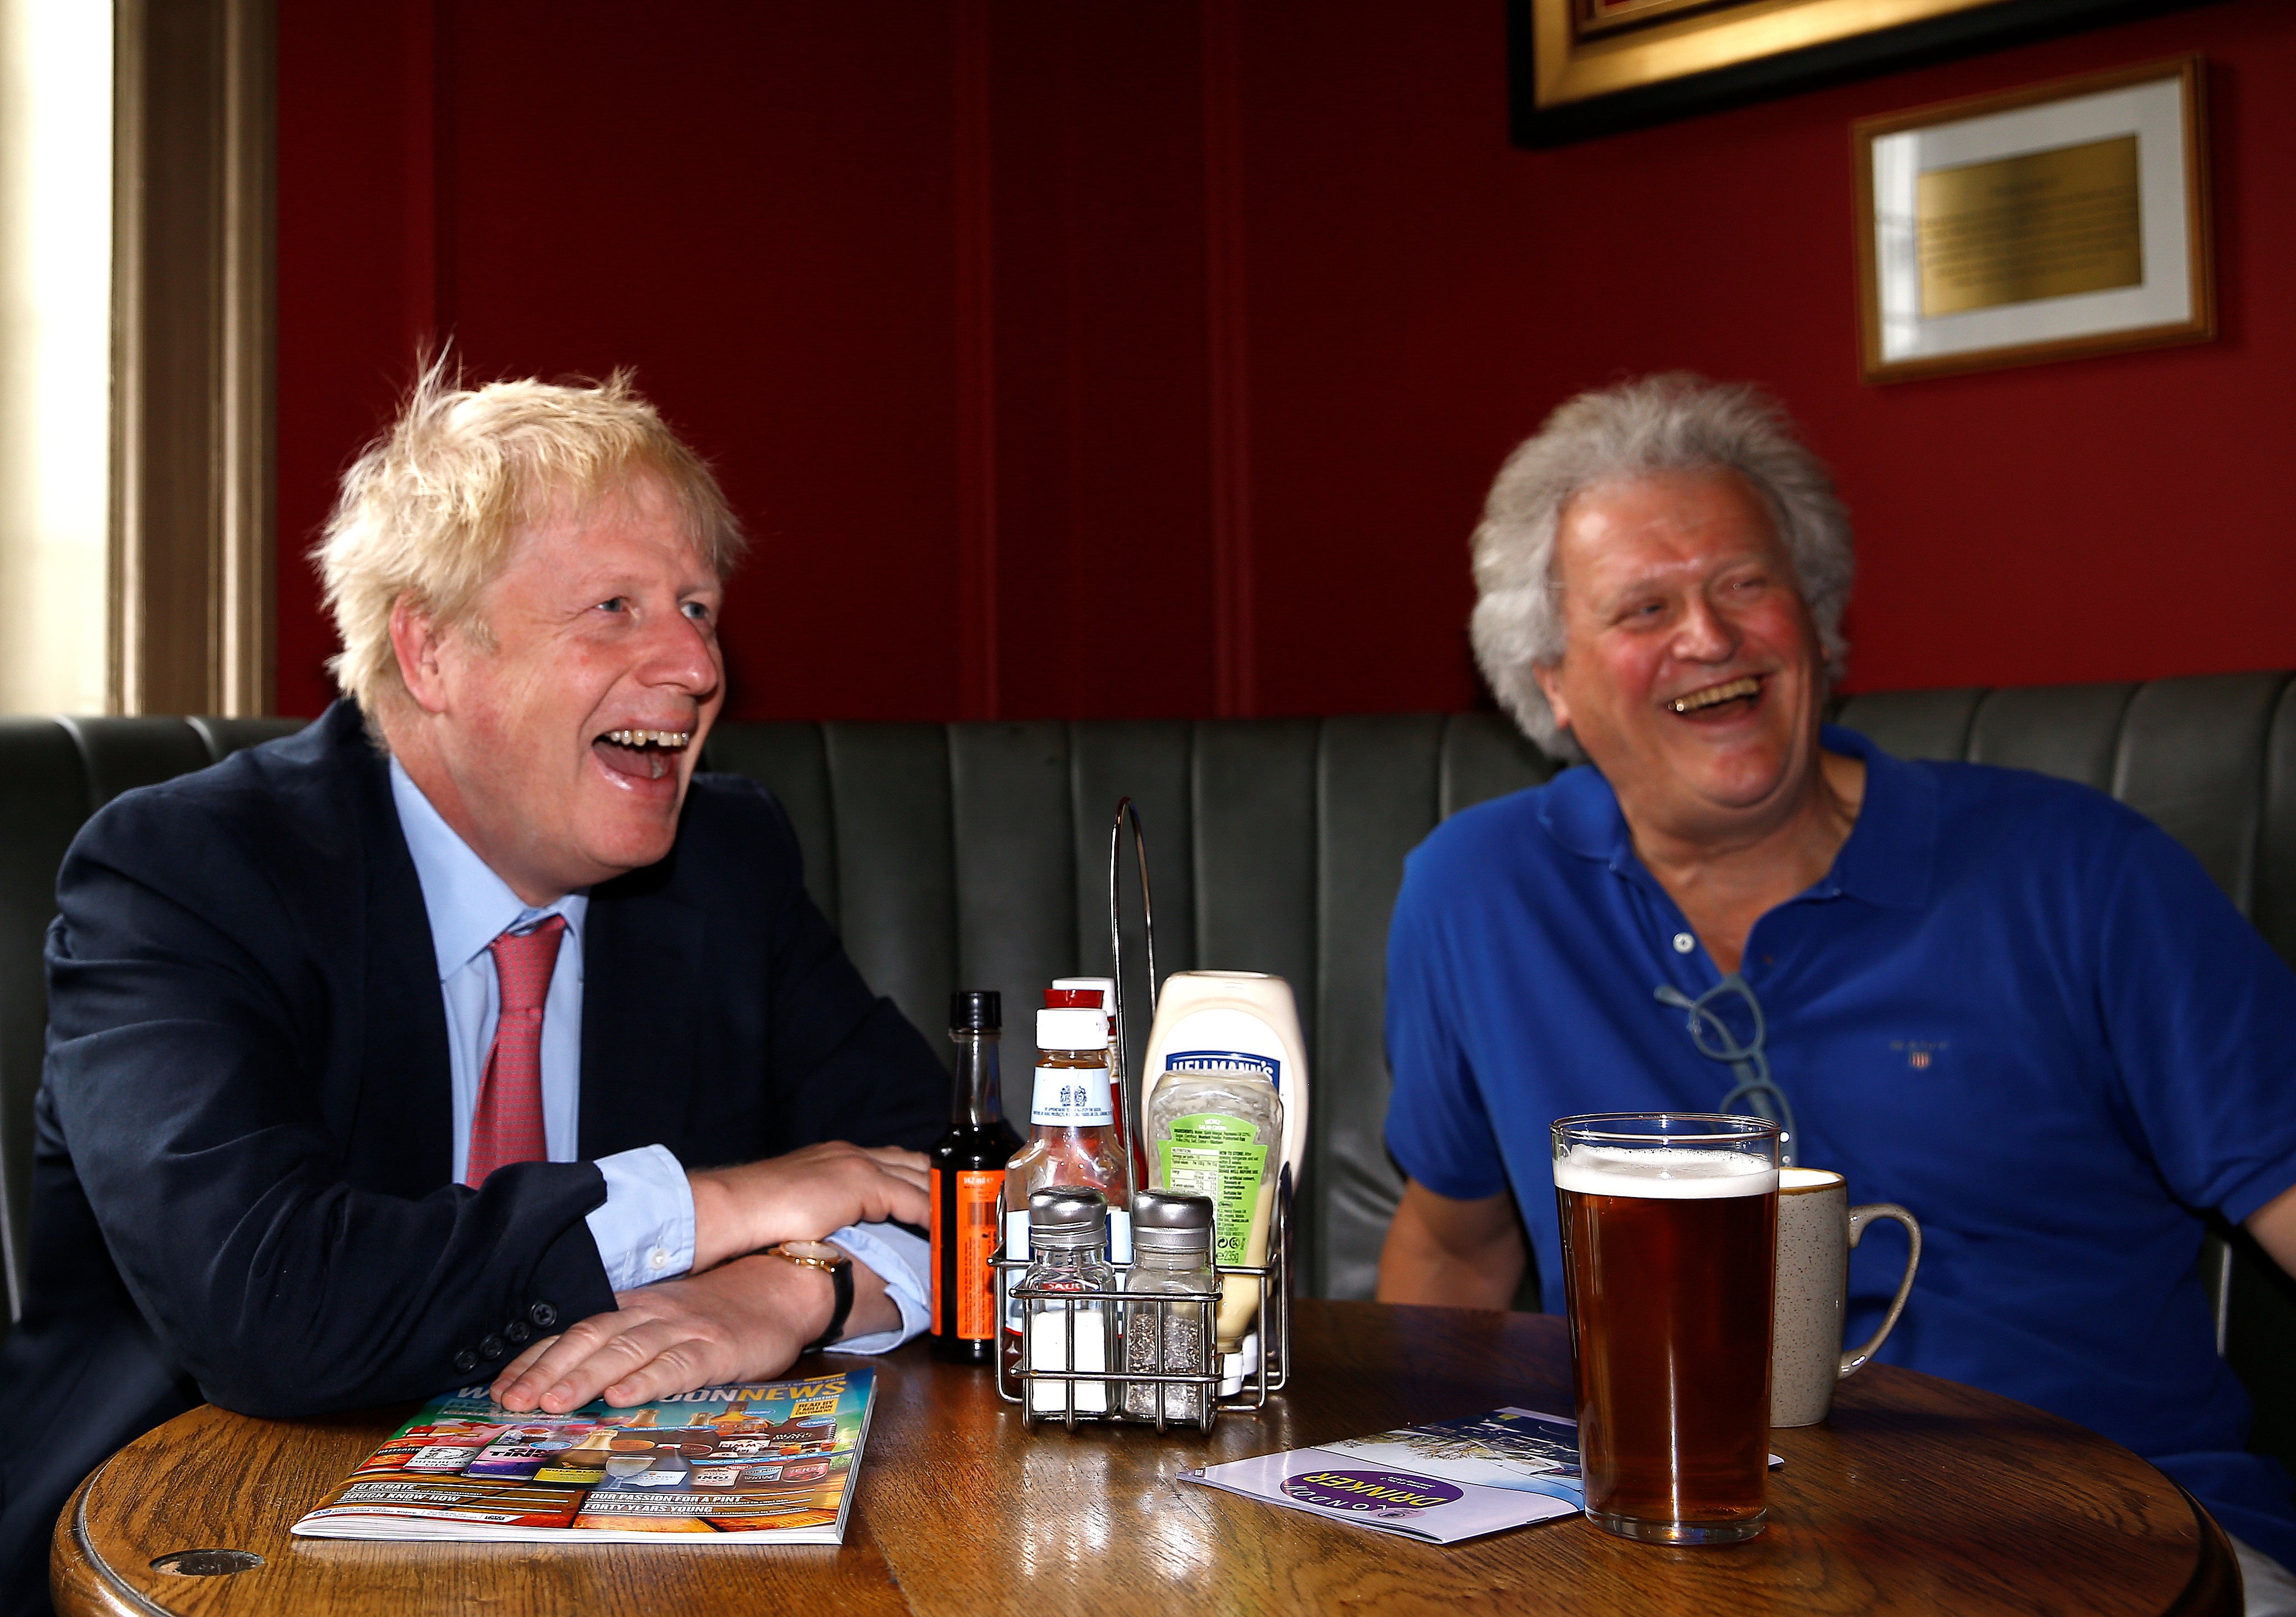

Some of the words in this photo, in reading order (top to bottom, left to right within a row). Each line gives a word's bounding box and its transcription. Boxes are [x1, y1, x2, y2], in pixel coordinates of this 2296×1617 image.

[387, 1493, 461, 1502] KNOW-HOW
[1284, 1486, 1387, 1511] LONDON
[1303, 1473, 1448, 1506] DRINKER
